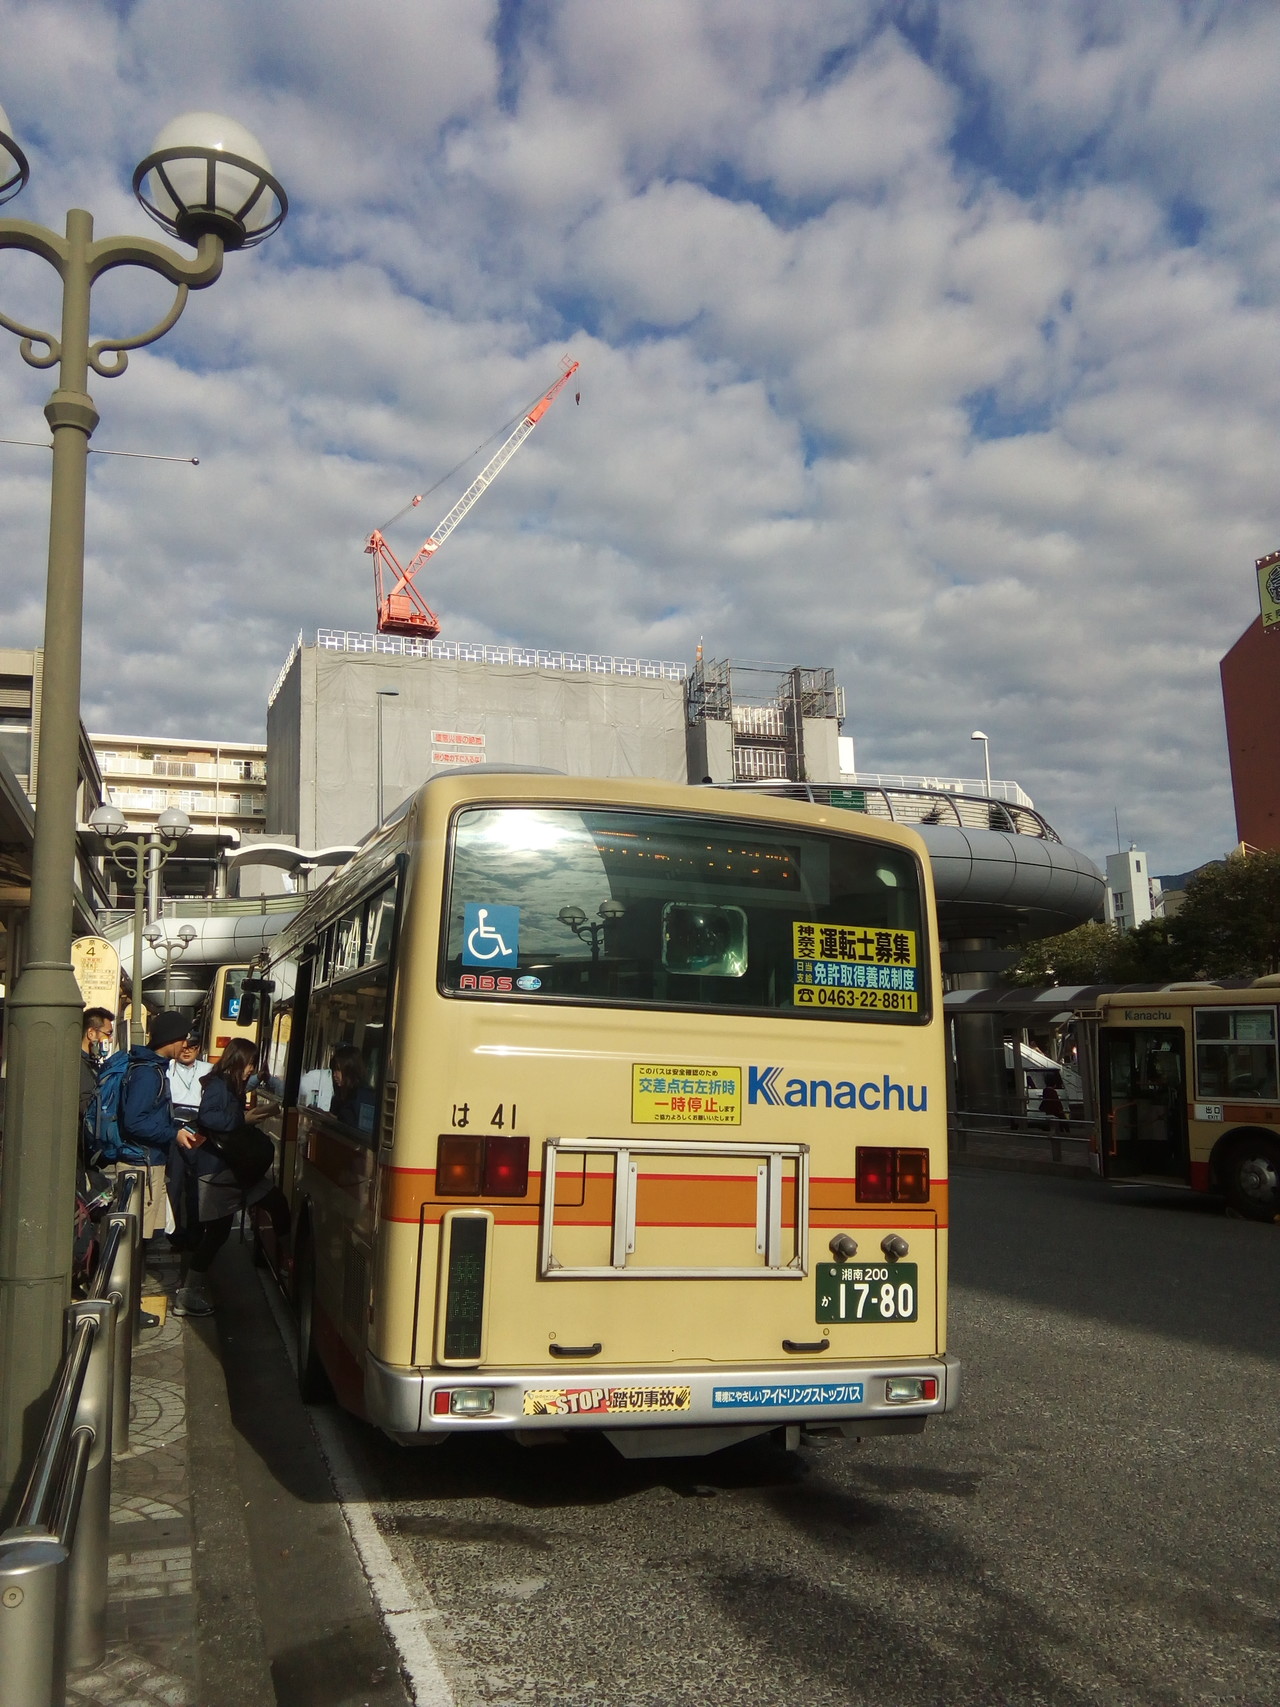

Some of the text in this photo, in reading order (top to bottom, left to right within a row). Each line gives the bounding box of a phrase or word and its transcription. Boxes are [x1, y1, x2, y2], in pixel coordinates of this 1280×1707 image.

[86, 947, 96, 956] 4
[797, 925, 911, 964] 神奈交 運転士募集
[460, 974, 513, 991] ABS
[796, 961, 915, 990] 日当 免許取得養成制度
[796, 973, 813, 984] 支給
[818, 989, 913, 1009] 0463-22-8811
[1125, 1011, 1171, 1020] Kanachu
[639, 1068, 718, 1076] このバスは安全確認のため
[639, 1078, 735, 1095] 交差点右左折時
[748, 1066, 927, 1111] Kanachu
[452, 1103, 516, 1130] は 41
[655, 1114, 735, 1122] ご協力よろしくお願いいたします
[1206, 1106, 1220, 1114] 出口
[842, 1268, 889, 1281] 湘南 200
[821, 1283, 914, 1318] か 17-80
[556, 1388, 675, 1415] STOP! 踏切事故
